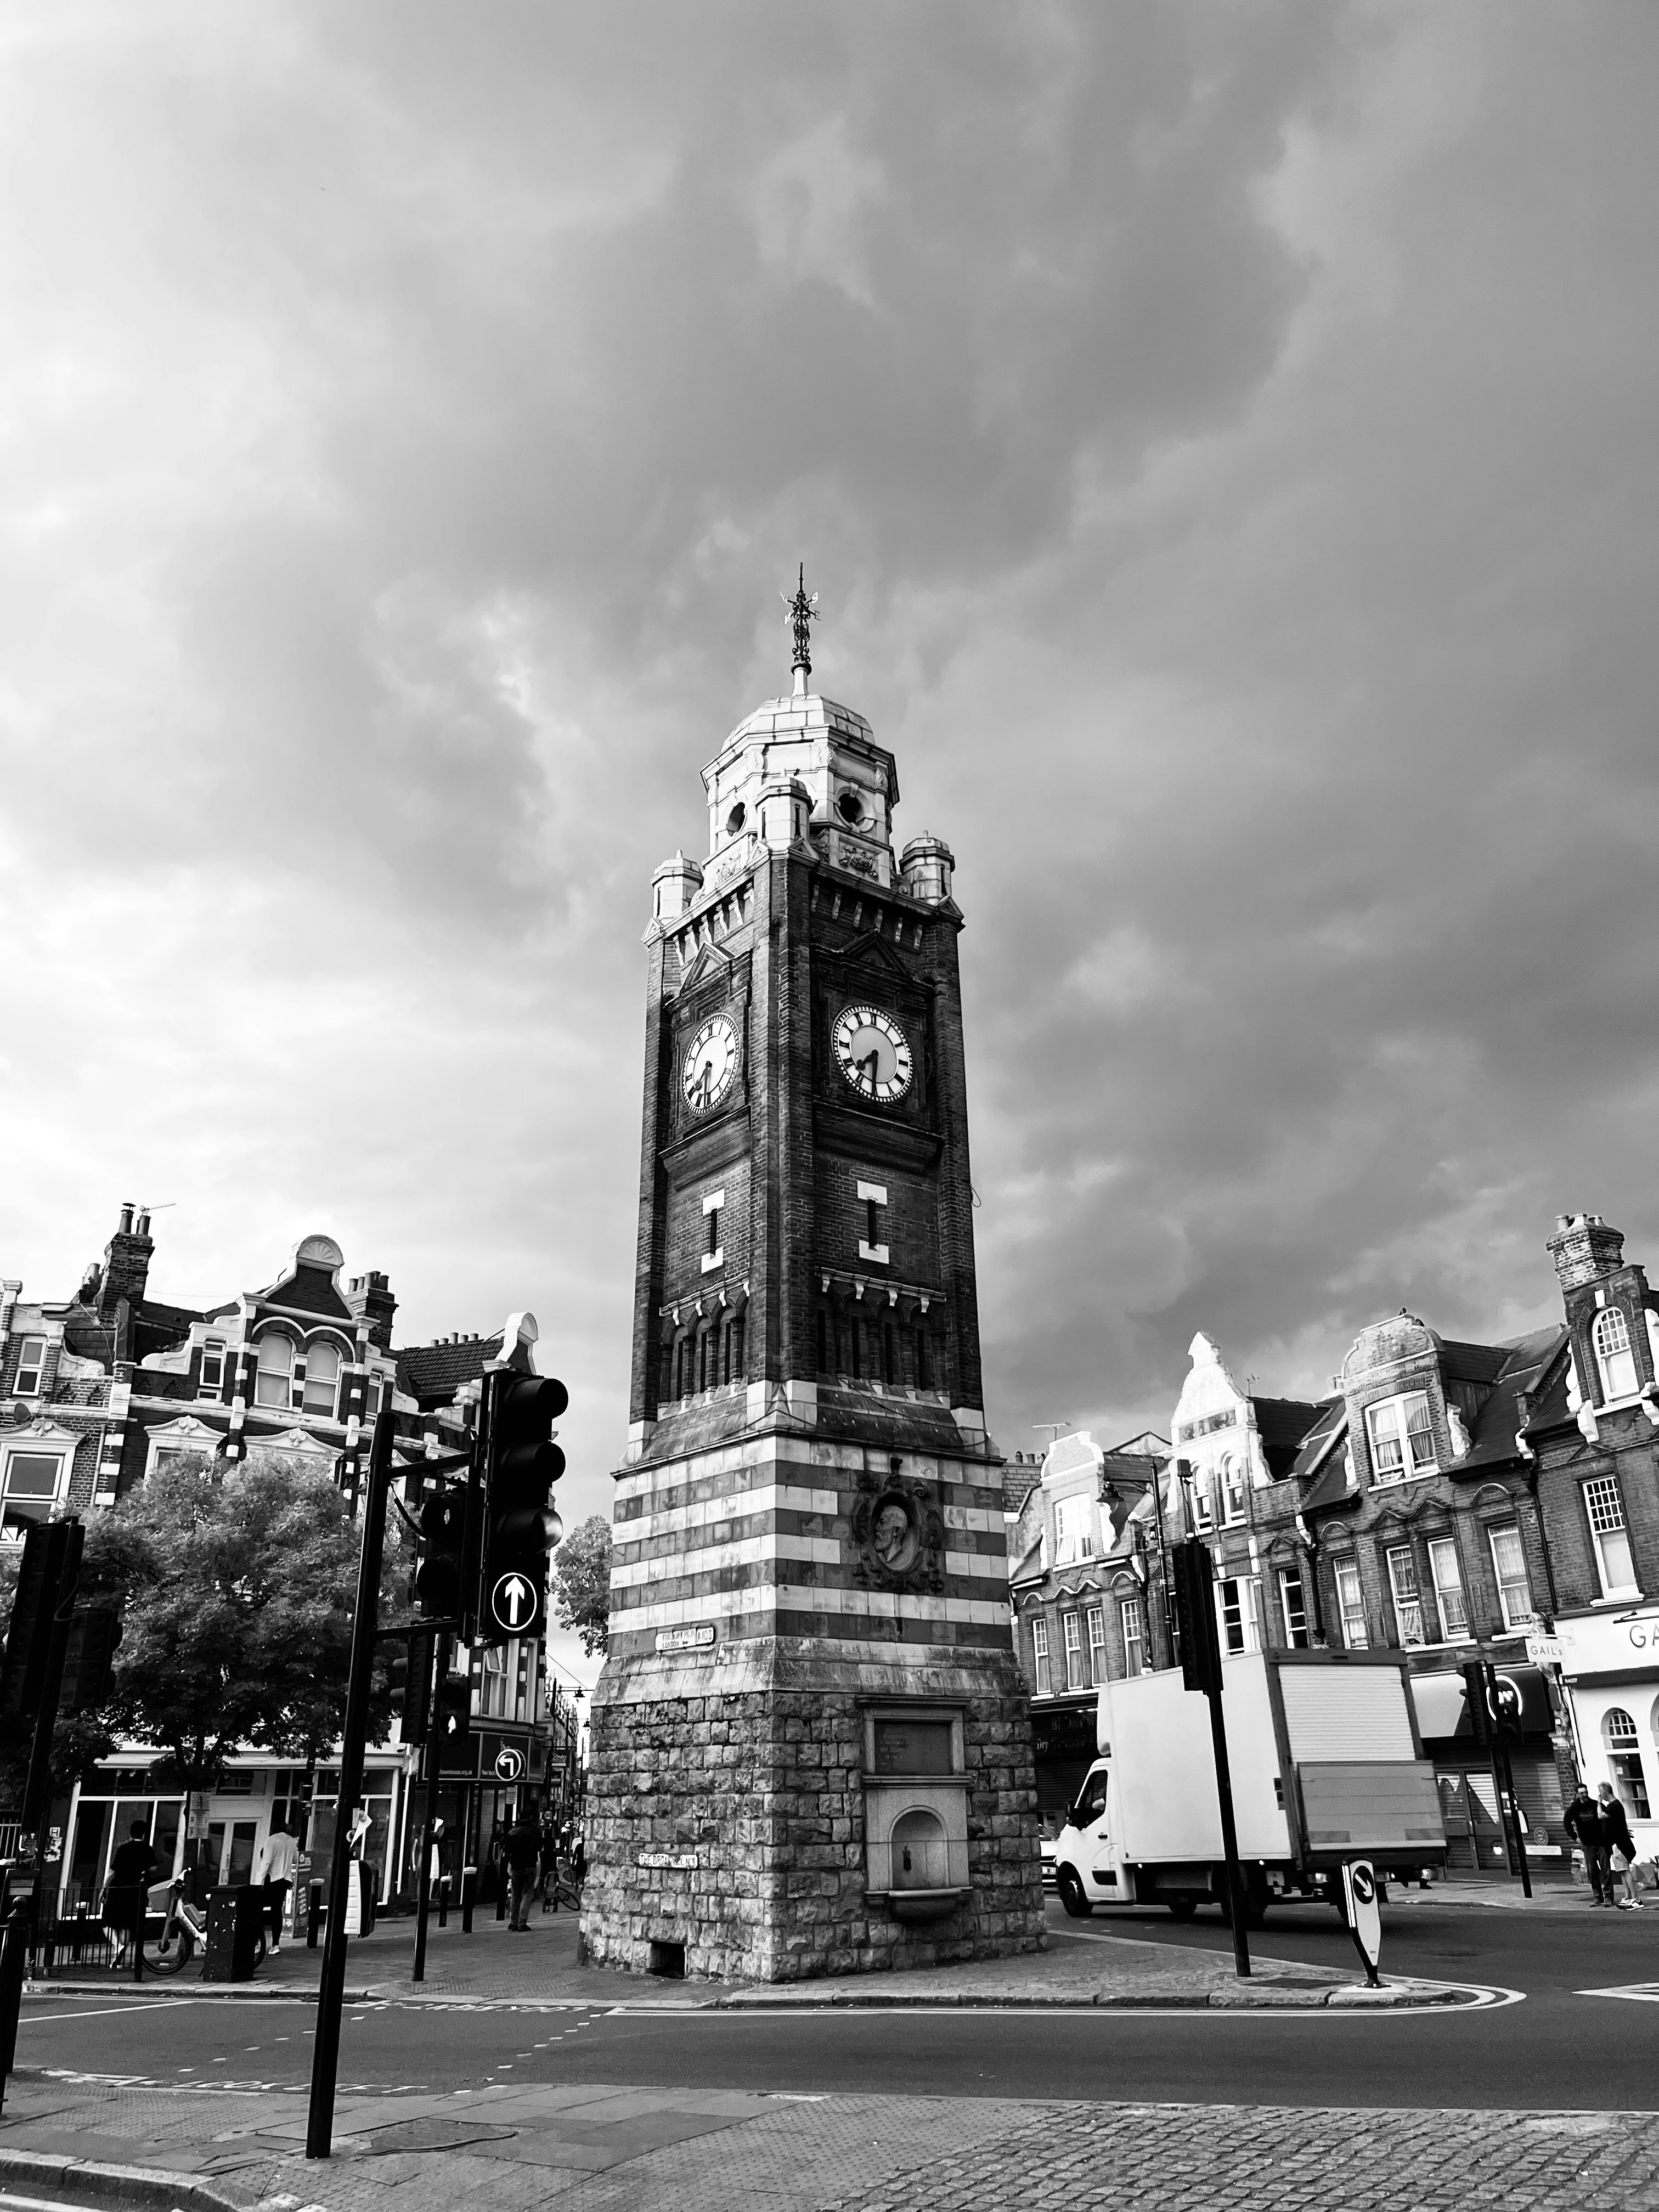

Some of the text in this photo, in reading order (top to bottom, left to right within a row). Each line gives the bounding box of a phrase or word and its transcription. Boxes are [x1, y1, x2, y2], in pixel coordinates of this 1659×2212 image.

[814, 610, 821, 621] E
[697, 1629, 712, 1642] A103
[662, 1640, 679, 1649] LONDON
[171, 2080, 291, 2089] LOOK
